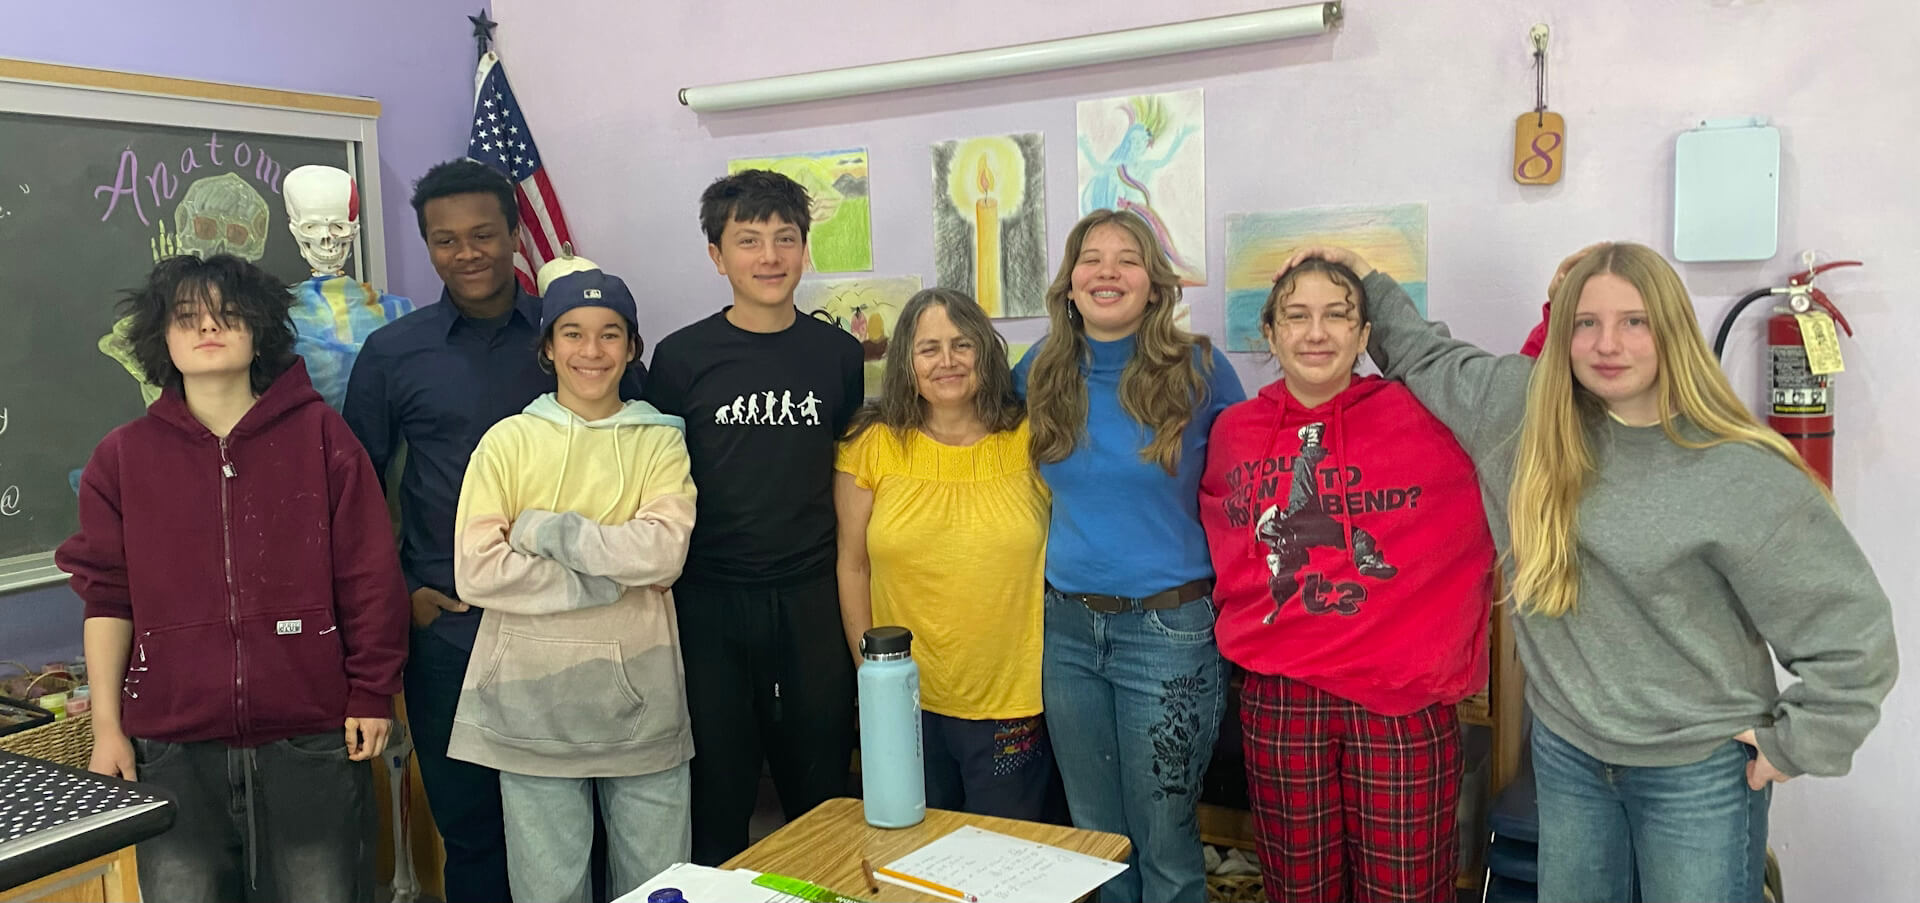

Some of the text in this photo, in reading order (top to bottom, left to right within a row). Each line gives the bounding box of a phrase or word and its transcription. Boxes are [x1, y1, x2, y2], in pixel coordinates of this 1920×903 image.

[1517, 131, 1561, 179] 8
[94, 133, 287, 226] Anatom
[1243, 455, 1298, 480] YOU
[1319, 466, 1362, 489] TO
[1321, 486, 1422, 515] BEND?
